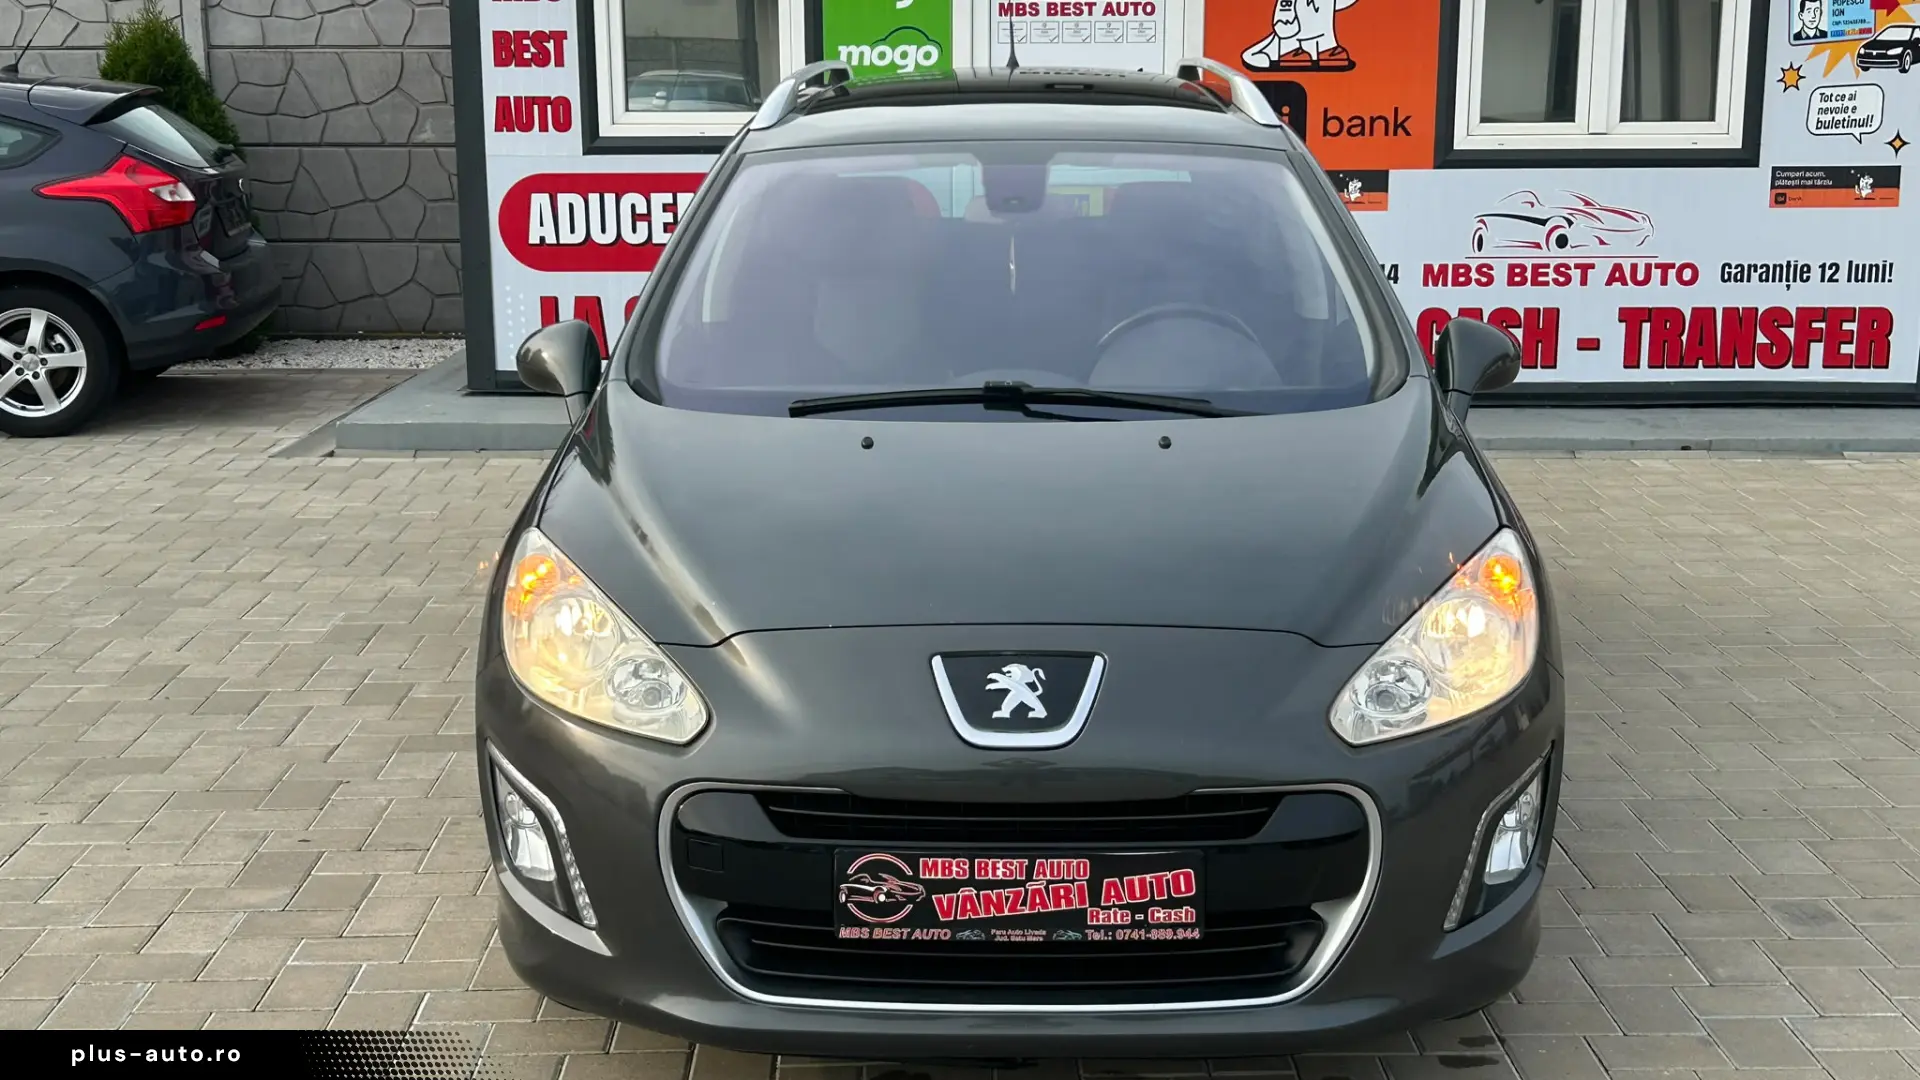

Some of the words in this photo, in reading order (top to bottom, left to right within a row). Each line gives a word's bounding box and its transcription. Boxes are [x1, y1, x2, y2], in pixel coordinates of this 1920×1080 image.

[998, 1, 1040, 17] MBS
[1046, 1, 1097, 17] BEST
[1102, 1, 1156, 16] AUTO
[1832, 8, 1845, 17] ION
[492, 30, 568, 68] BEST
[838, 44, 939, 73] mogo
[1819, 92, 1833, 103] Tot
[1834, 93, 1846, 102] ce
[1848, 90, 1857, 101] ai
[494, 95, 572, 133] AUTO
[1817, 103, 1850, 115] nevoie
[1851, 105, 1858, 114] e
[1322, 107, 1412, 137] bank
[1815, 114, 1874, 130] buletinul!
[528, 192, 696, 246] ADUCE
[1380, 264, 1399, 284] 4
[1422, 263, 1495, 287] MBS
[1506, 263, 1596, 287] BEST
[1604, 262, 1700, 287] AUTO
[1720, 260, 1811, 291] Garanție
[1818, 262, 1840, 283] 12
[1847, 260, 1894, 283] luni!
[1618, 306, 1894, 370] TRANSFER
[919, 857, 969, 879] MBS
[975, 858, 1028, 880] BEST
[1034, 858, 1090, 880] AUTO
[1101, 868, 1196, 906] AUTO
[1087, 907, 1131, 925] Rate
[1148, 906, 1196, 924] Cash
[838, 927, 870, 939] MBS
[872, 927, 911, 940] BEST
[911, 927, 951, 941] AUTO
